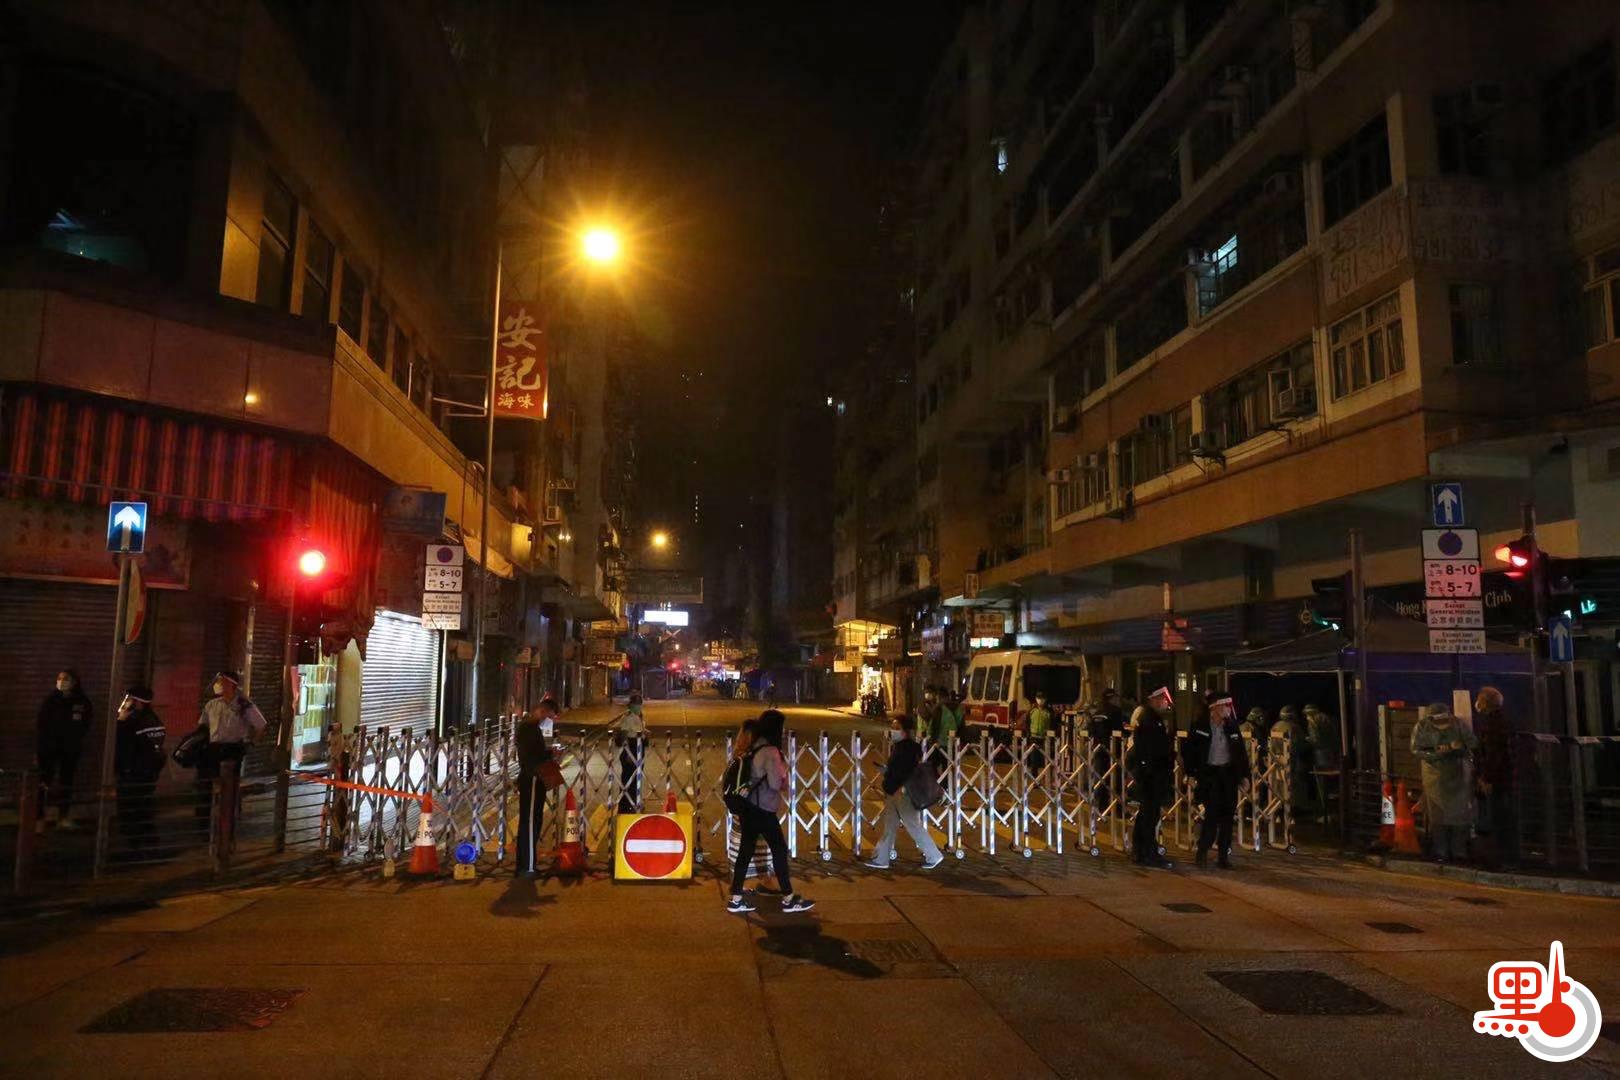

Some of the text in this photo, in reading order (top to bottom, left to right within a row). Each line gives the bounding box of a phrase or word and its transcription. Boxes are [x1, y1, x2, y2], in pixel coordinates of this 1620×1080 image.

[496, 308, 543, 390] 安記
[497, 392, 535, 409] 海味
[440, 569, 461, 578] 8-10
[1446, 564, 1477, 576] 8-10
[439, 581, 457, 589] 5-7
[1447, 581, 1473, 593] 5-7
